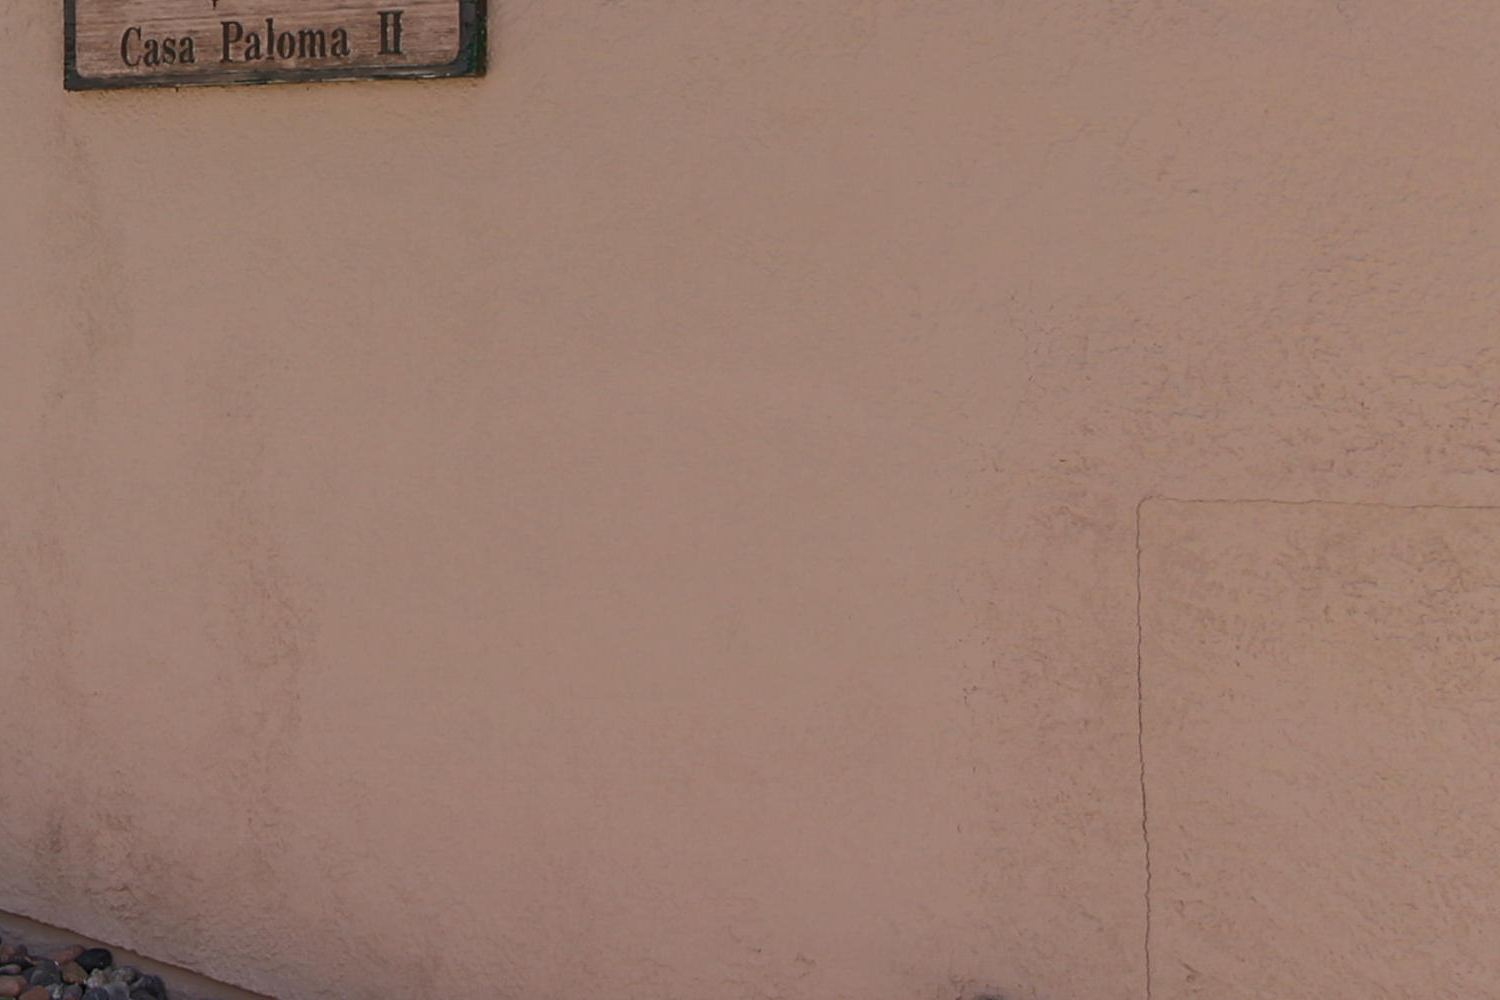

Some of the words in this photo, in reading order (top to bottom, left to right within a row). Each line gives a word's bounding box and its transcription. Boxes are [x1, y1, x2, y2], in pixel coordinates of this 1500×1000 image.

[120, 26, 196, 67] Casa
[220, 18, 350, 63] Paloma
[377, 10, 404, 55] II
